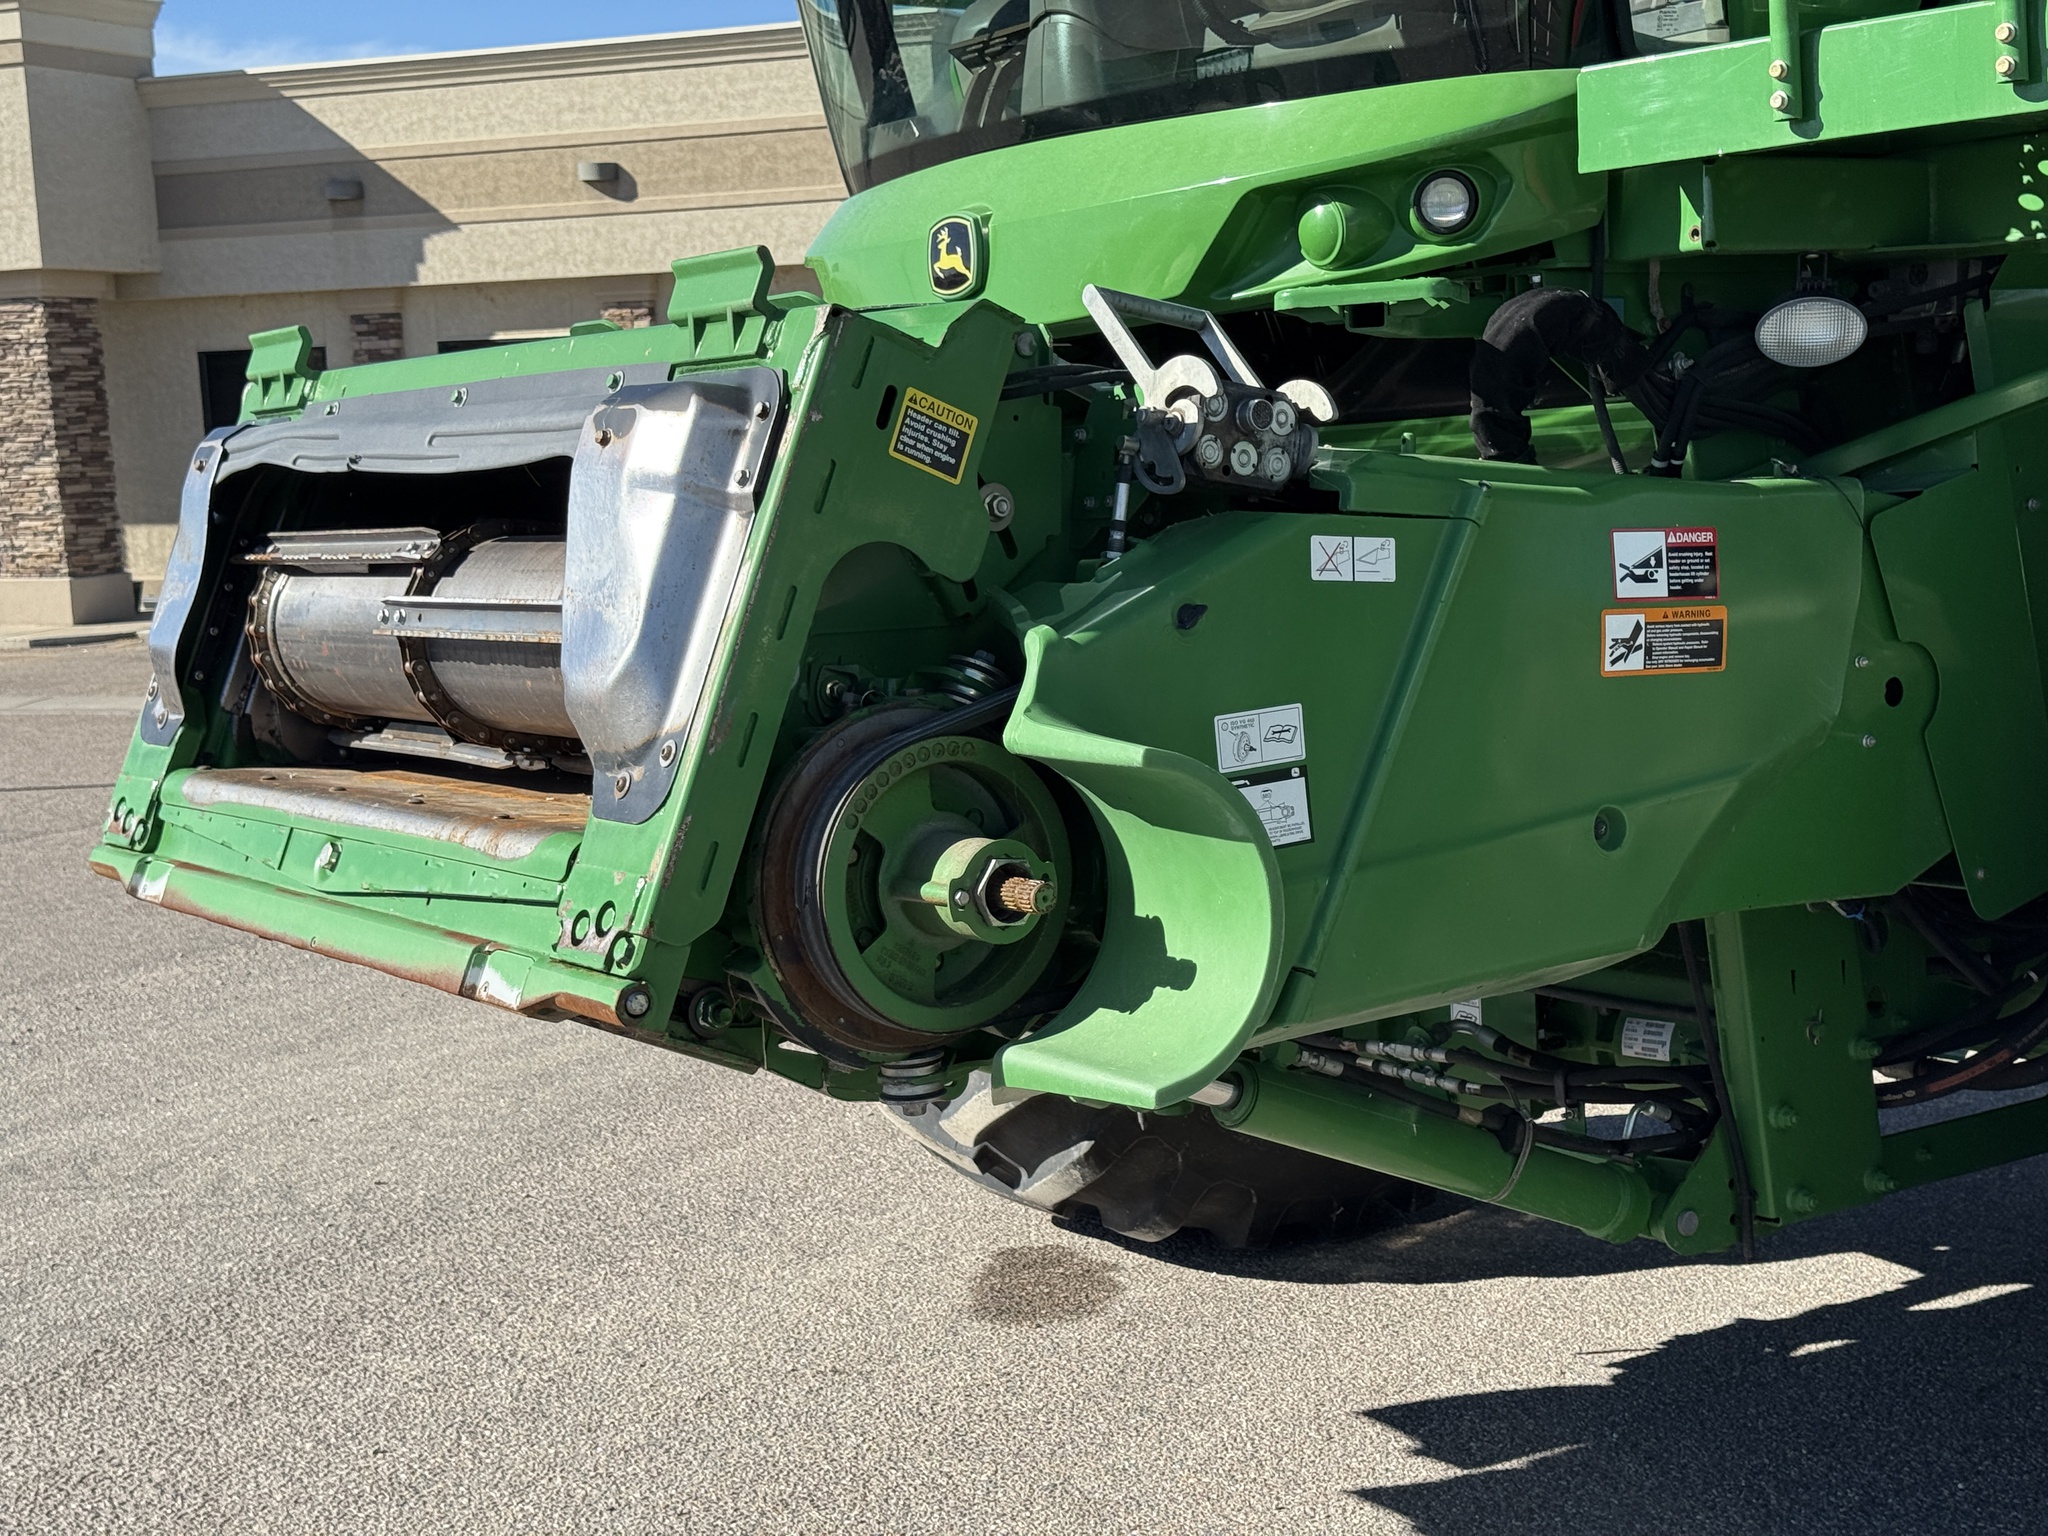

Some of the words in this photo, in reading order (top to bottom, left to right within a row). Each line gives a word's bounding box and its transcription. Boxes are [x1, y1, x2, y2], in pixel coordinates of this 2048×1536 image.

[907, 408, 933, 425] Header
[934, 422, 947, 432] can
[949, 427, 960, 439] tilt.
[919, 397, 973, 430] CAUTION
[904, 417, 925, 431] Avoid
[926, 427, 956, 447] crushing
[900, 434, 916, 446] clear
[916, 442, 934, 454] when
[934, 450, 956, 464] engine
[904, 446, 932, 464] running.
[932, 438, 948, 452] Stay
[1676, 532, 1713, 542] DANGER
[1672, 610, 1711, 618] WARNING
